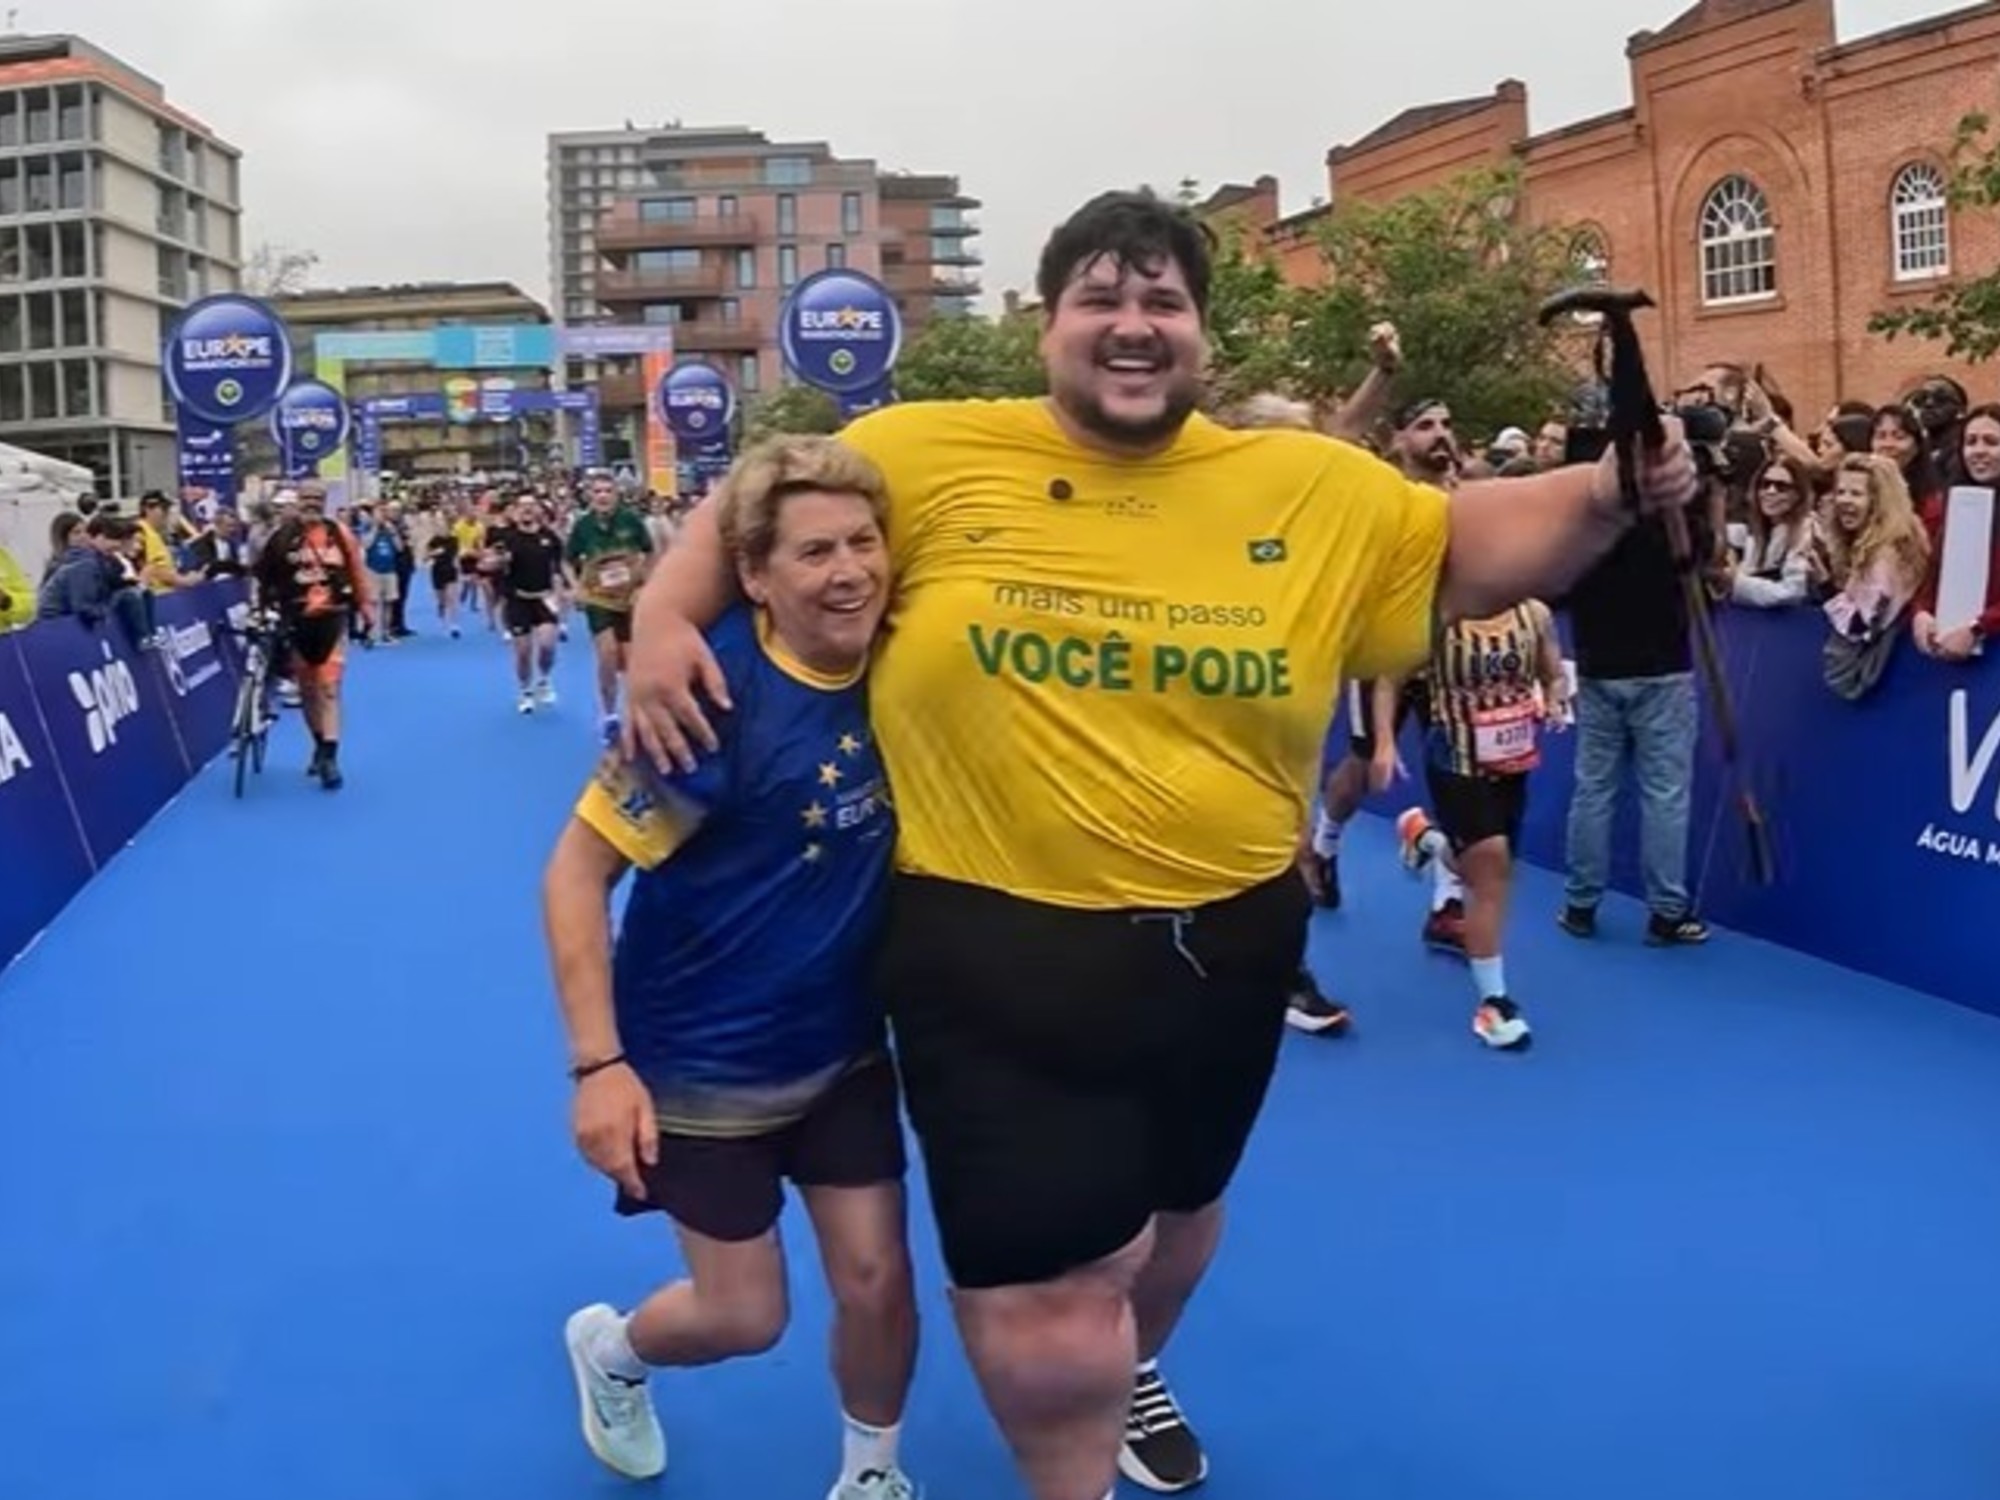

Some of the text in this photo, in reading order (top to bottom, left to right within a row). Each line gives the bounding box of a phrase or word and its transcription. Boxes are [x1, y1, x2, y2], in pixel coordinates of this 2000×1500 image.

[994, 582, 1266, 629] mais um passo
[969, 624, 1293, 698] VOCÊ PODE
[0, 712, 33, 784] A
[1950, 688, 2000, 820] V
[837, 793, 886, 829] EUR
[1916, 822, 1981, 861] ÁGUA
